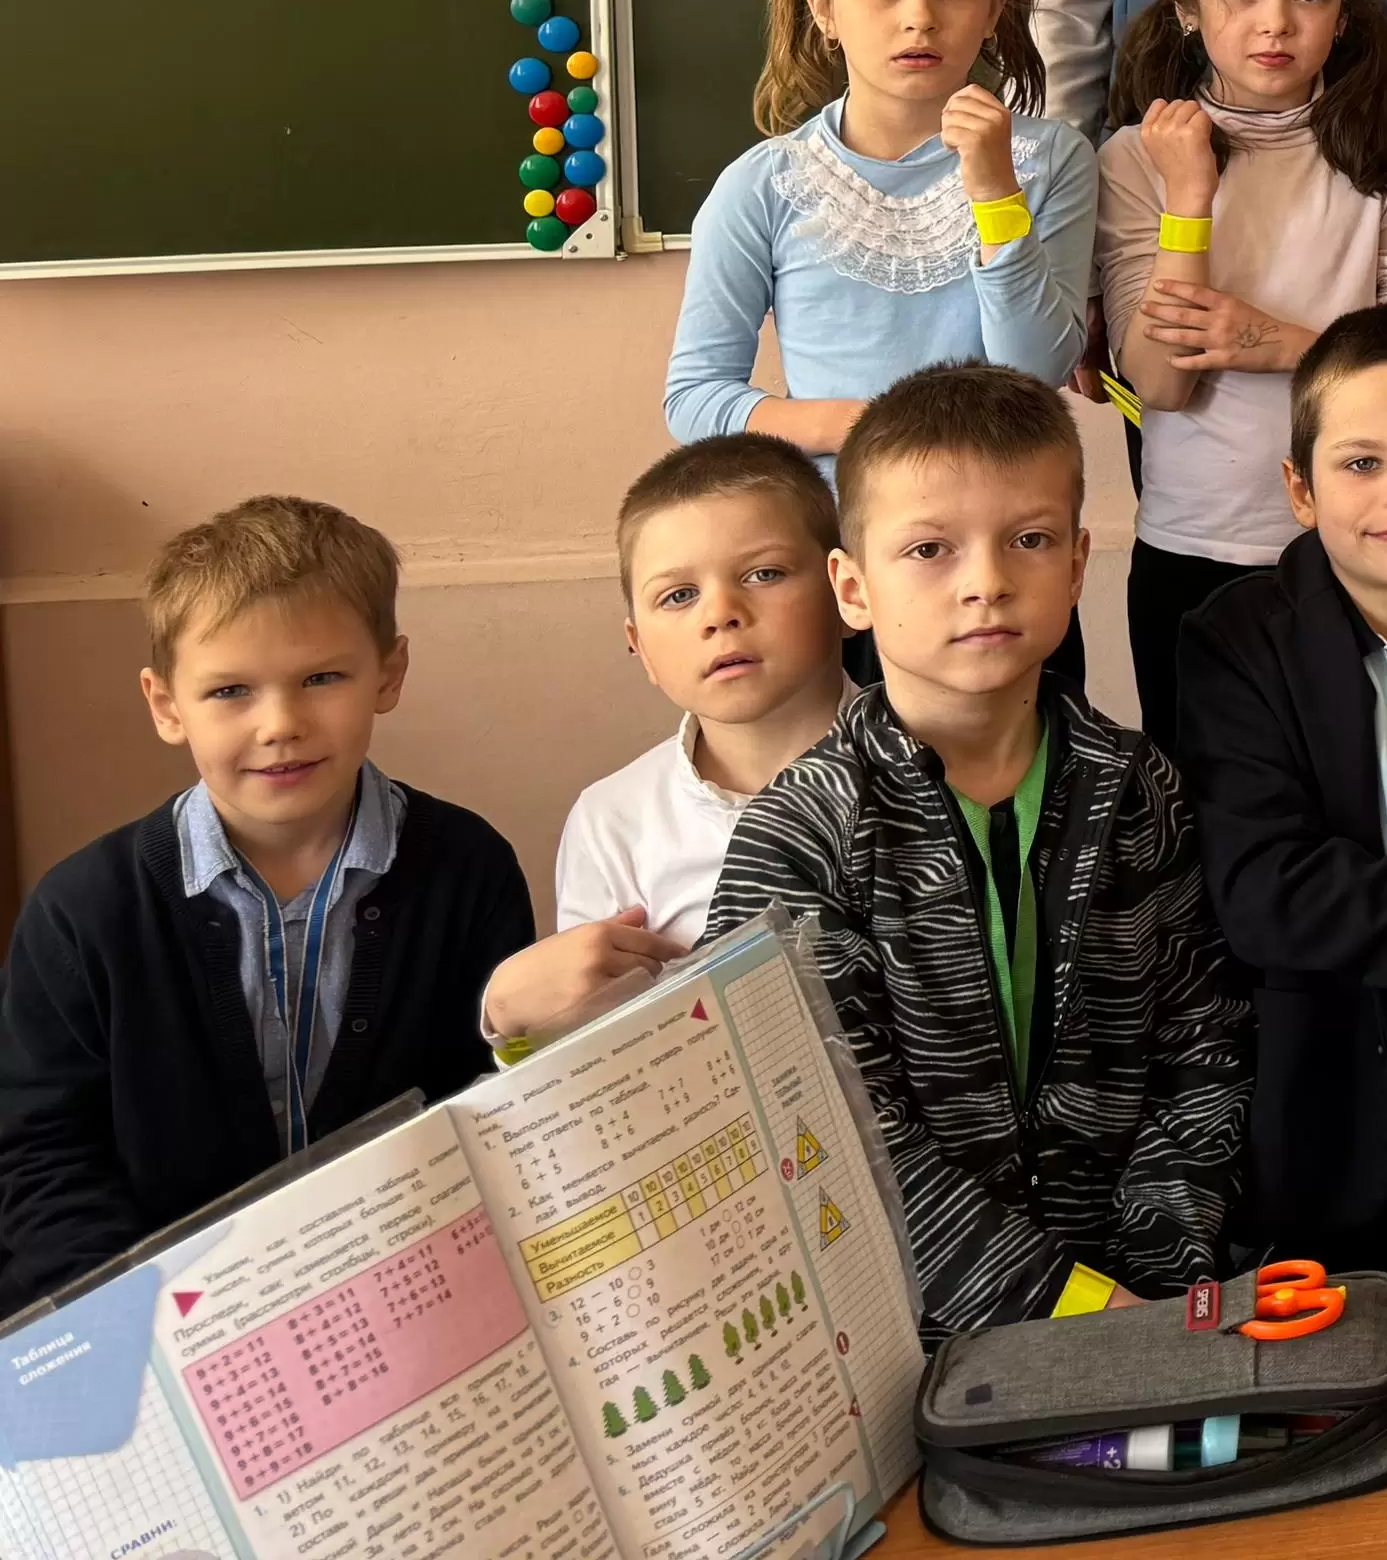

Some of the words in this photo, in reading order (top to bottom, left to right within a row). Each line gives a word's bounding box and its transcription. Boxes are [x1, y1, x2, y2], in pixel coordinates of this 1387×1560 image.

[538, 1231, 615, 1274] Вычитаемое
[546, 1261, 604, 1293] Разность
[11, 1331, 75, 1369] Таблица
